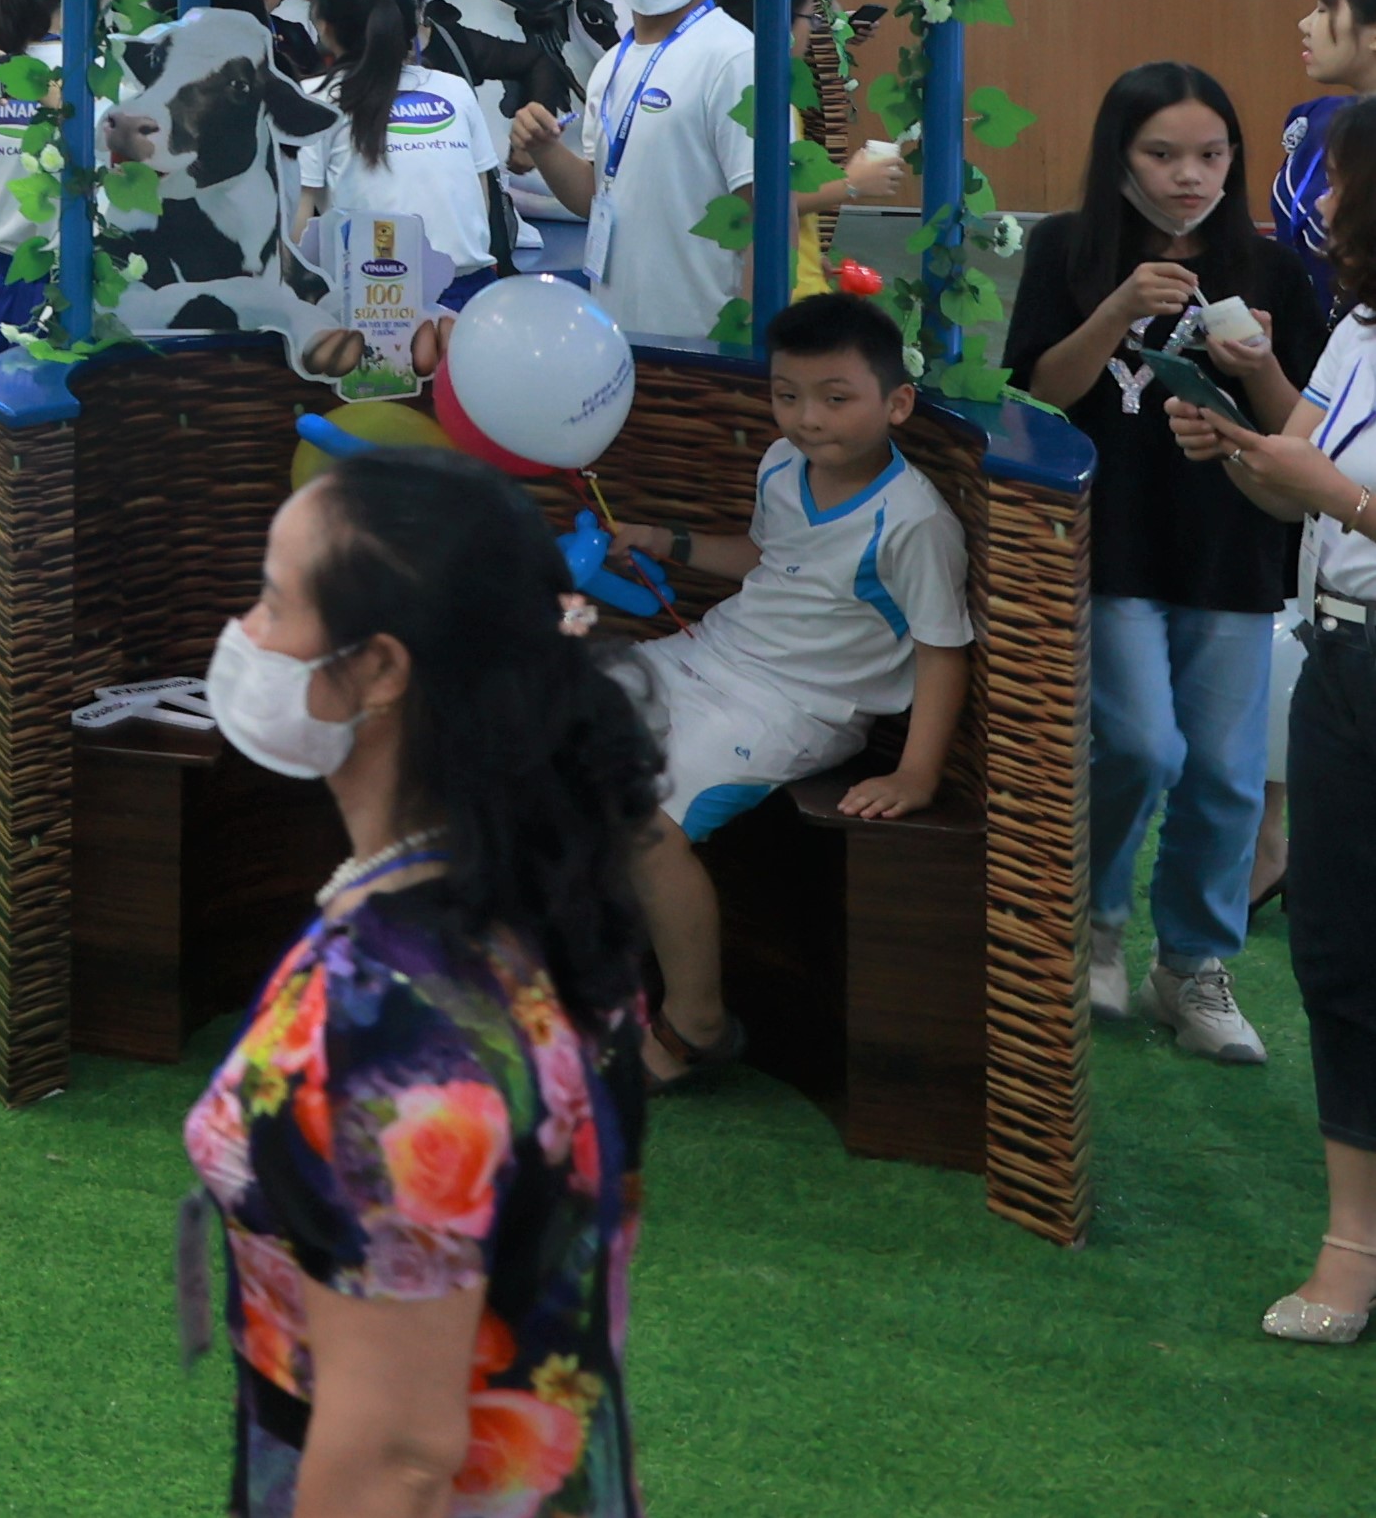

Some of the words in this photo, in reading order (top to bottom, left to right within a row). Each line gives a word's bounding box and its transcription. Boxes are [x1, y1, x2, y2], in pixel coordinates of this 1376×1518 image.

[389, 101, 450, 118] NAMILK
[404, 142, 425, 151] CAO
[363, 264, 405, 274] VINAMILK
